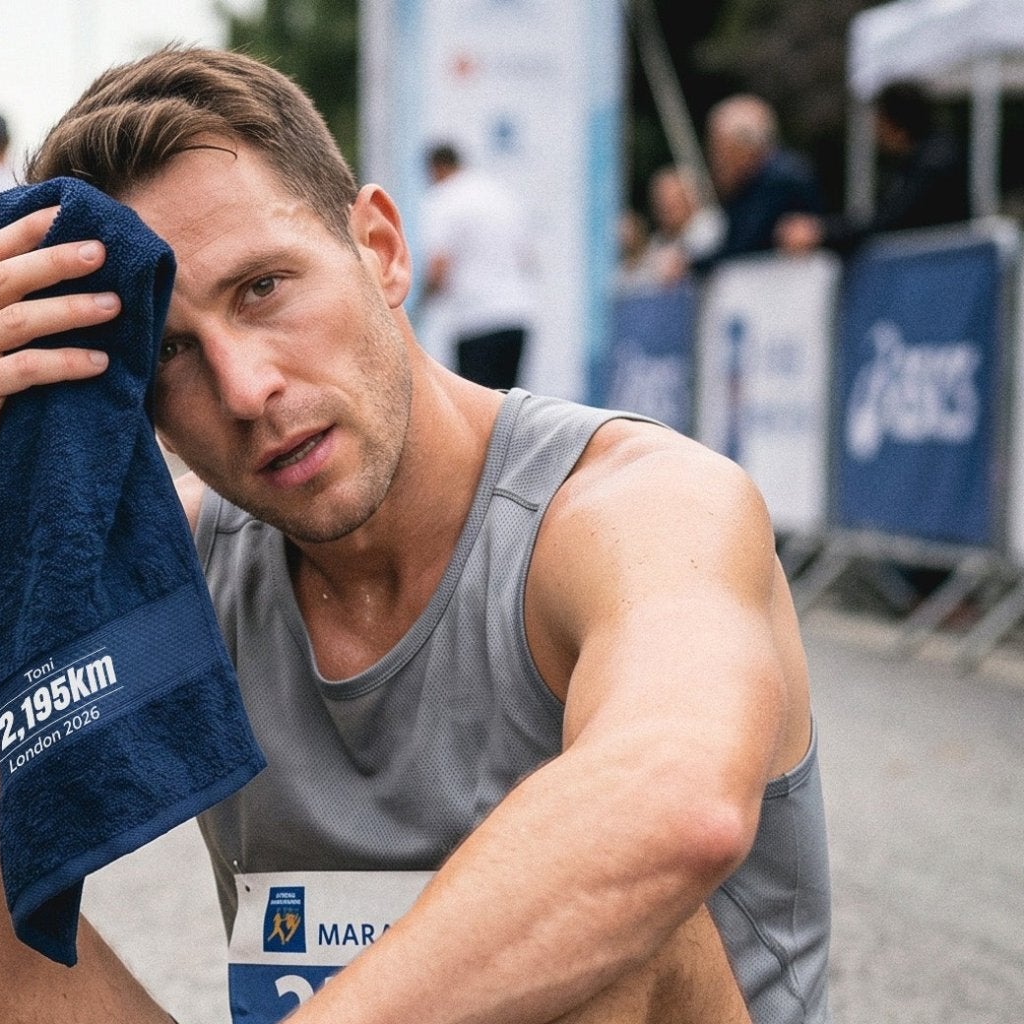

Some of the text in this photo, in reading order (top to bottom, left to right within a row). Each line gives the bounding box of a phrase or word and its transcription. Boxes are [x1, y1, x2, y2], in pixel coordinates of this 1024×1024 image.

[24, 657, 55, 682] Toni
[9, 705, 100, 774] London 2026
